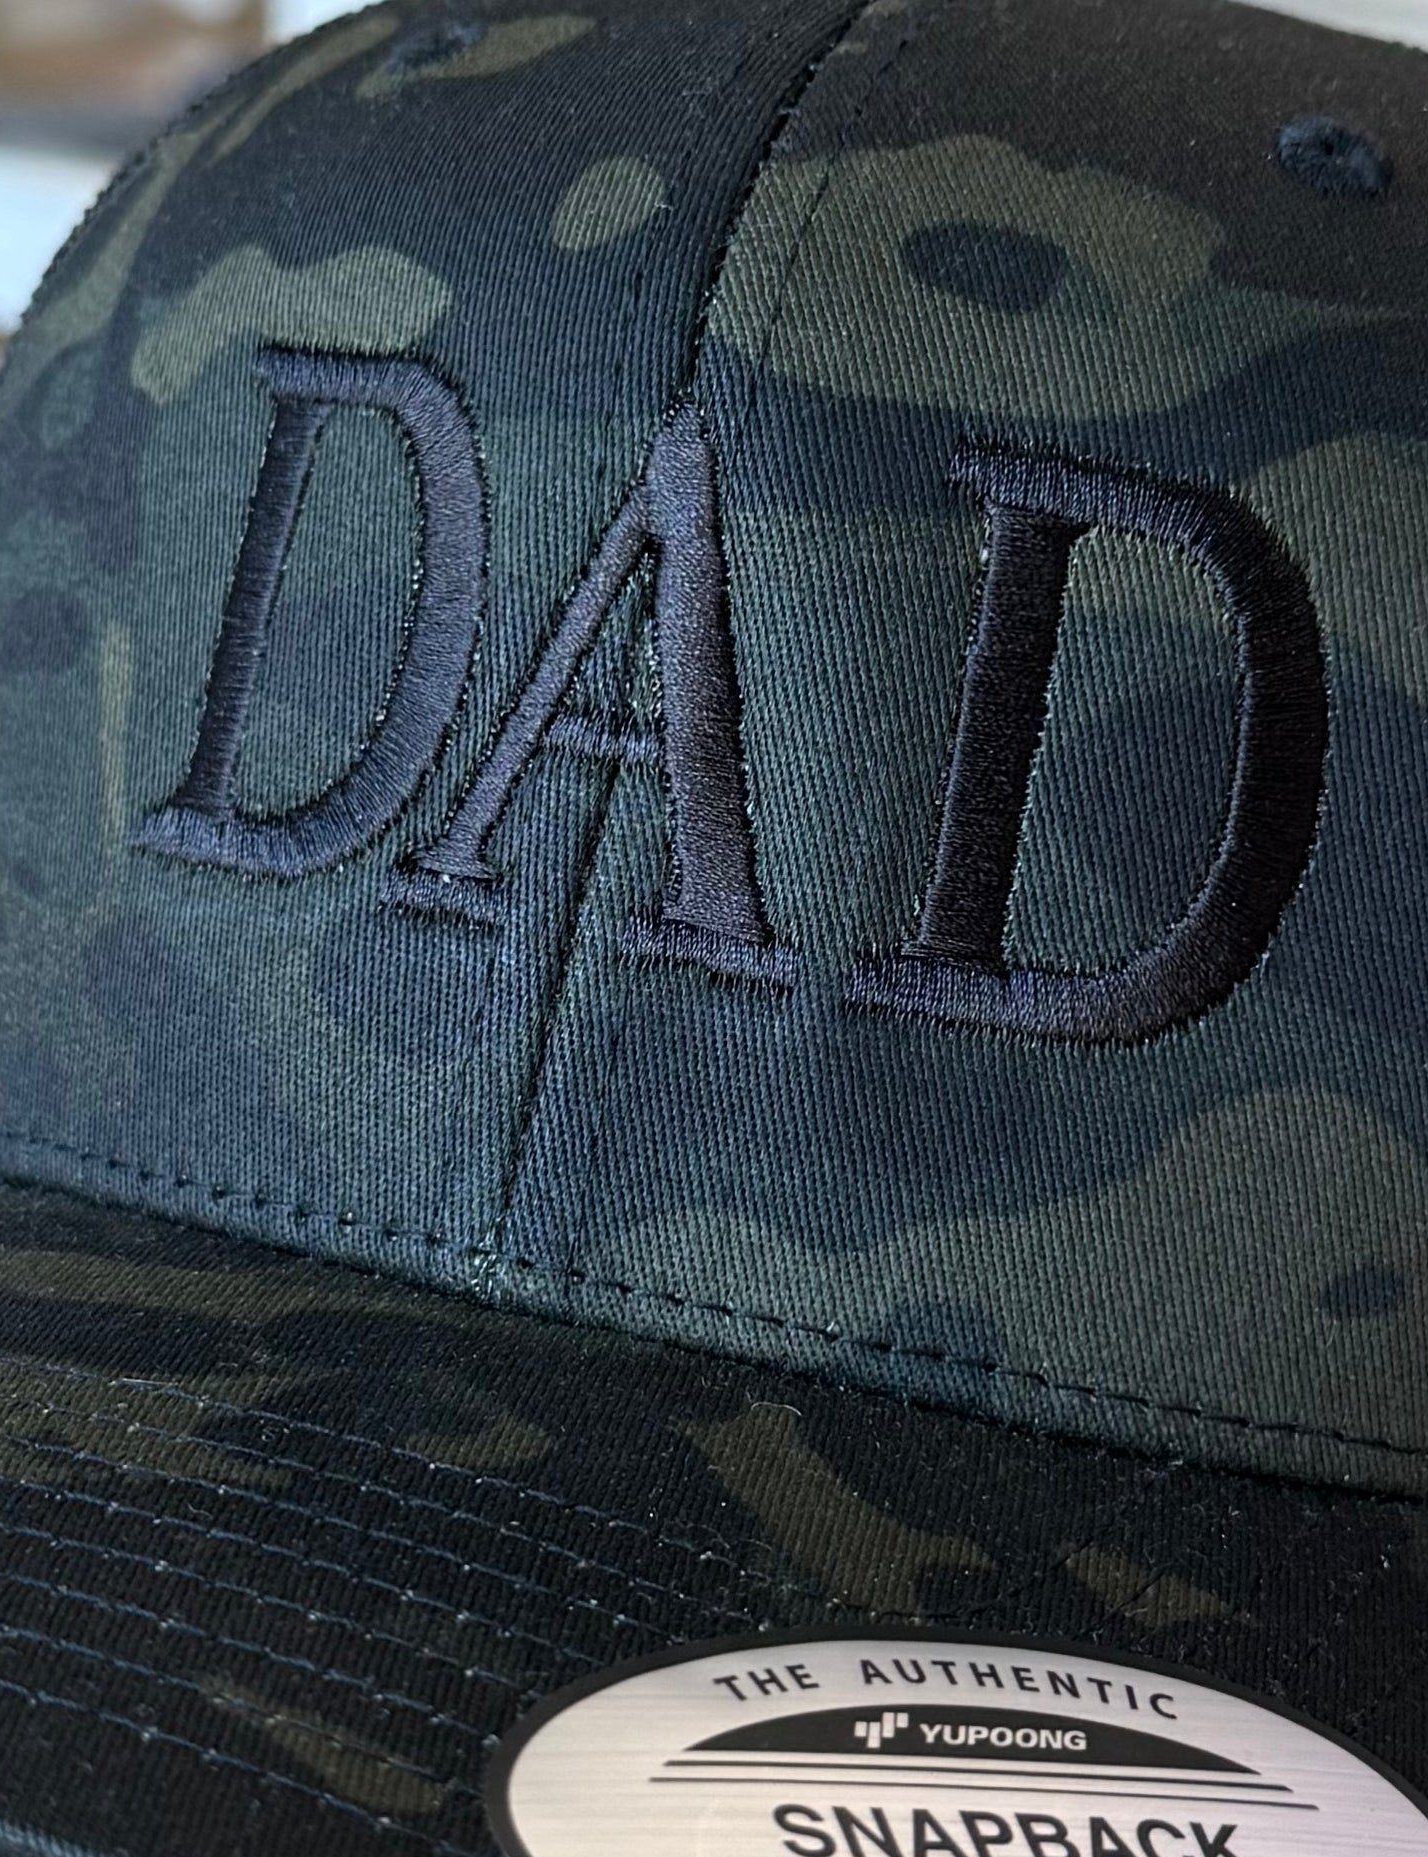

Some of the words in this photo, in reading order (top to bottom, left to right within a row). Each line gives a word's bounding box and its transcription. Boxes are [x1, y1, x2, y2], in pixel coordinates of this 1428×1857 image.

[127, 342, 1330, 1049] DAD
[713, 1661, 821, 1703] THE
[858, 1657, 1178, 1720] AUTHENTIC
[918, 1722, 1088, 1751] YUPOONG
